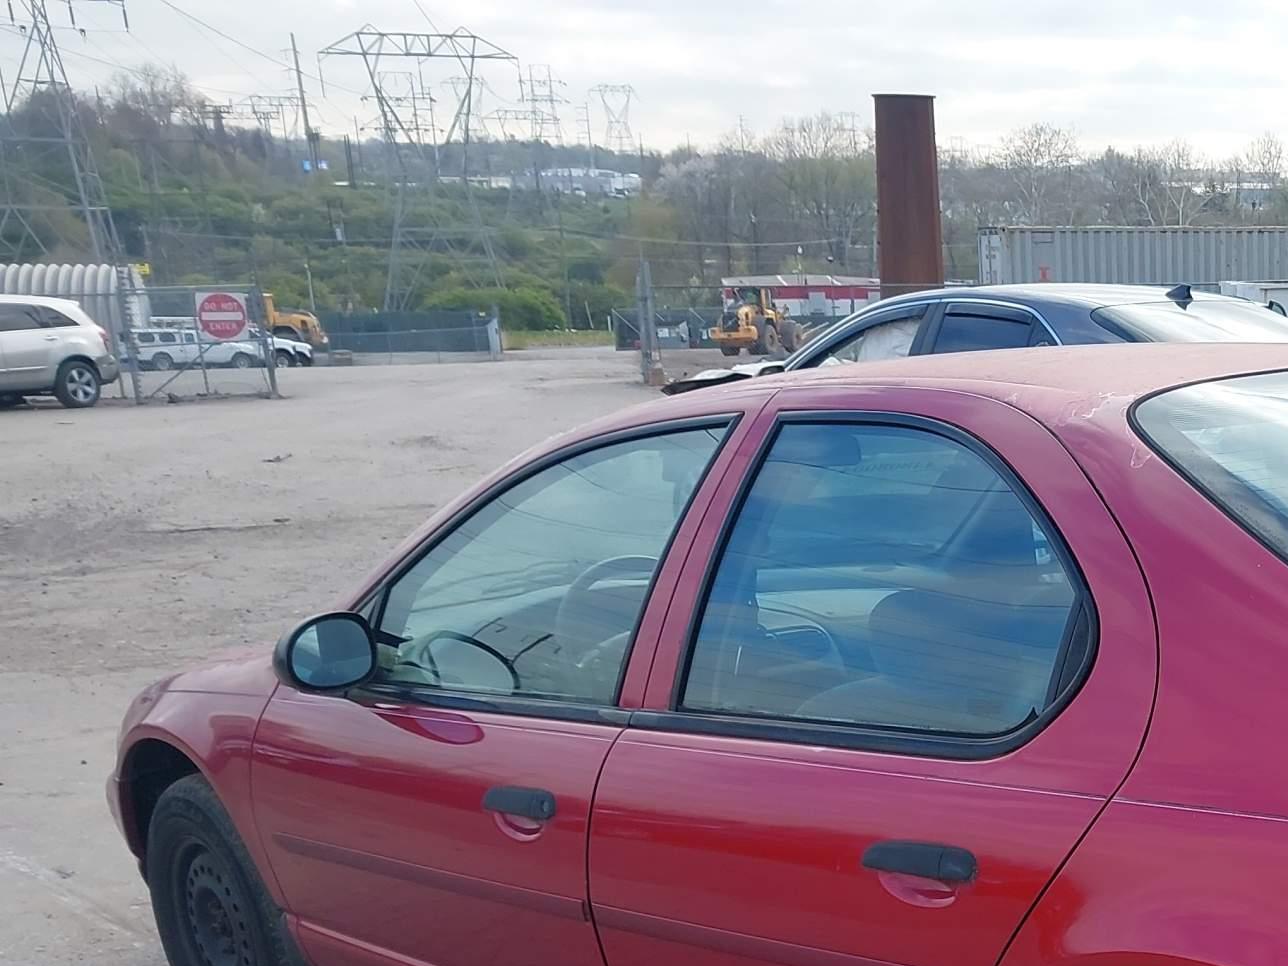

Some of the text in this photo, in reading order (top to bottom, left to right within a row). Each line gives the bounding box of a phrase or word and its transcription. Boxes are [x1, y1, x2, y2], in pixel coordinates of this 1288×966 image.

[203, 302, 238, 311] DO NOT
[208, 322, 238, 330] ENTER
